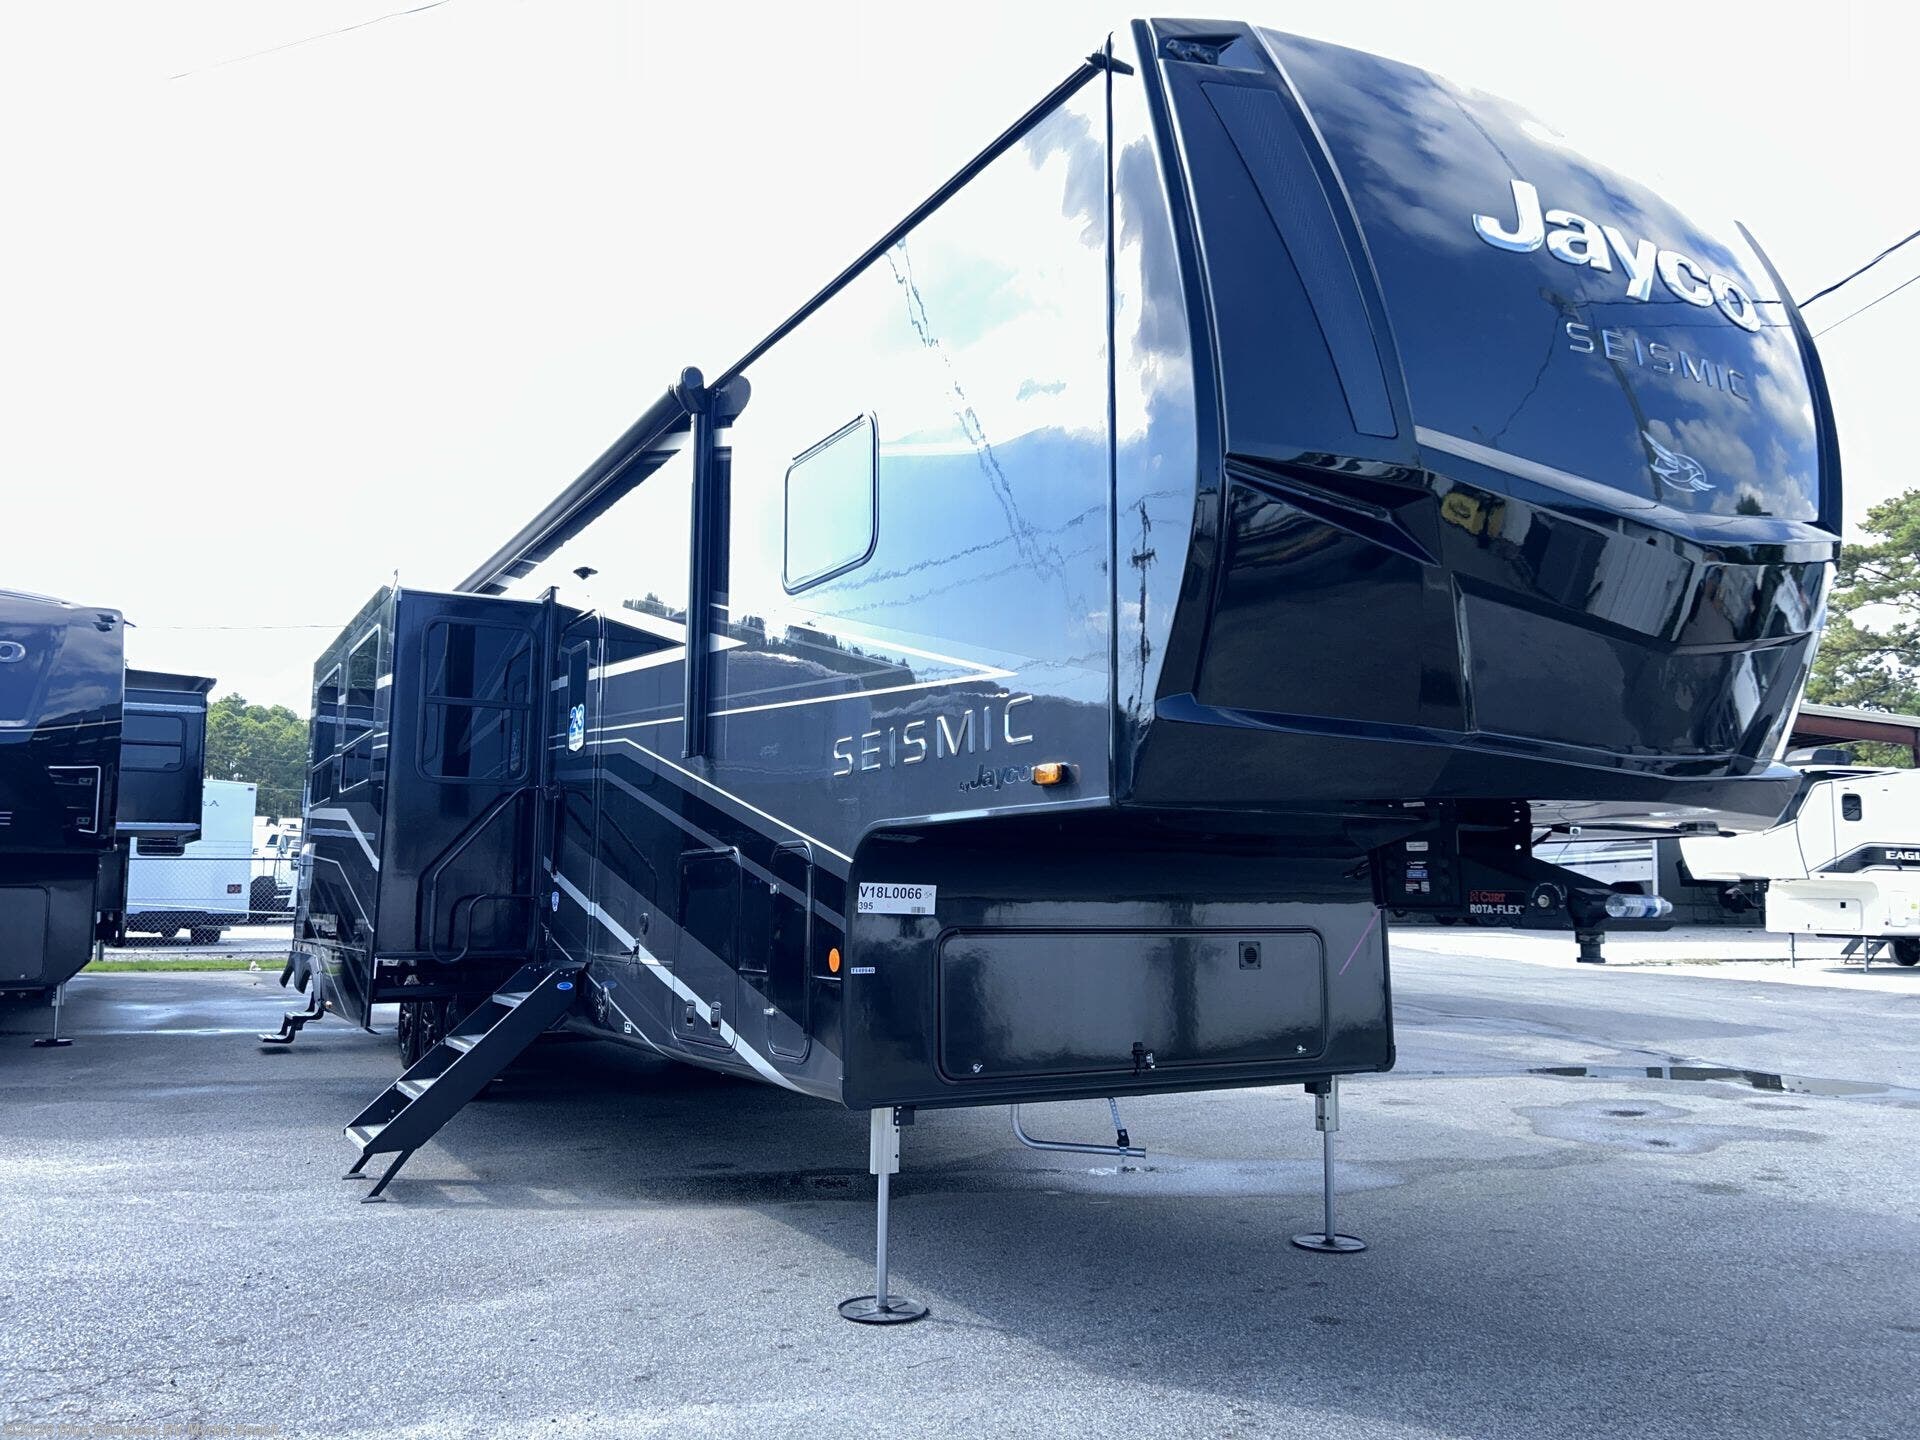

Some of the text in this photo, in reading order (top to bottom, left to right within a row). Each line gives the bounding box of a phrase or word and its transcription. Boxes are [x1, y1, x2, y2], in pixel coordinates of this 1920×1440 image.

[1472, 178, 1761, 333] Jayco
[1565, 321, 1750, 402] SEISMIC
[833, 694, 1033, 777] SEISMIC
[858, 901, 874, 910] 395
[860, 885, 922, 900] V18L0066
